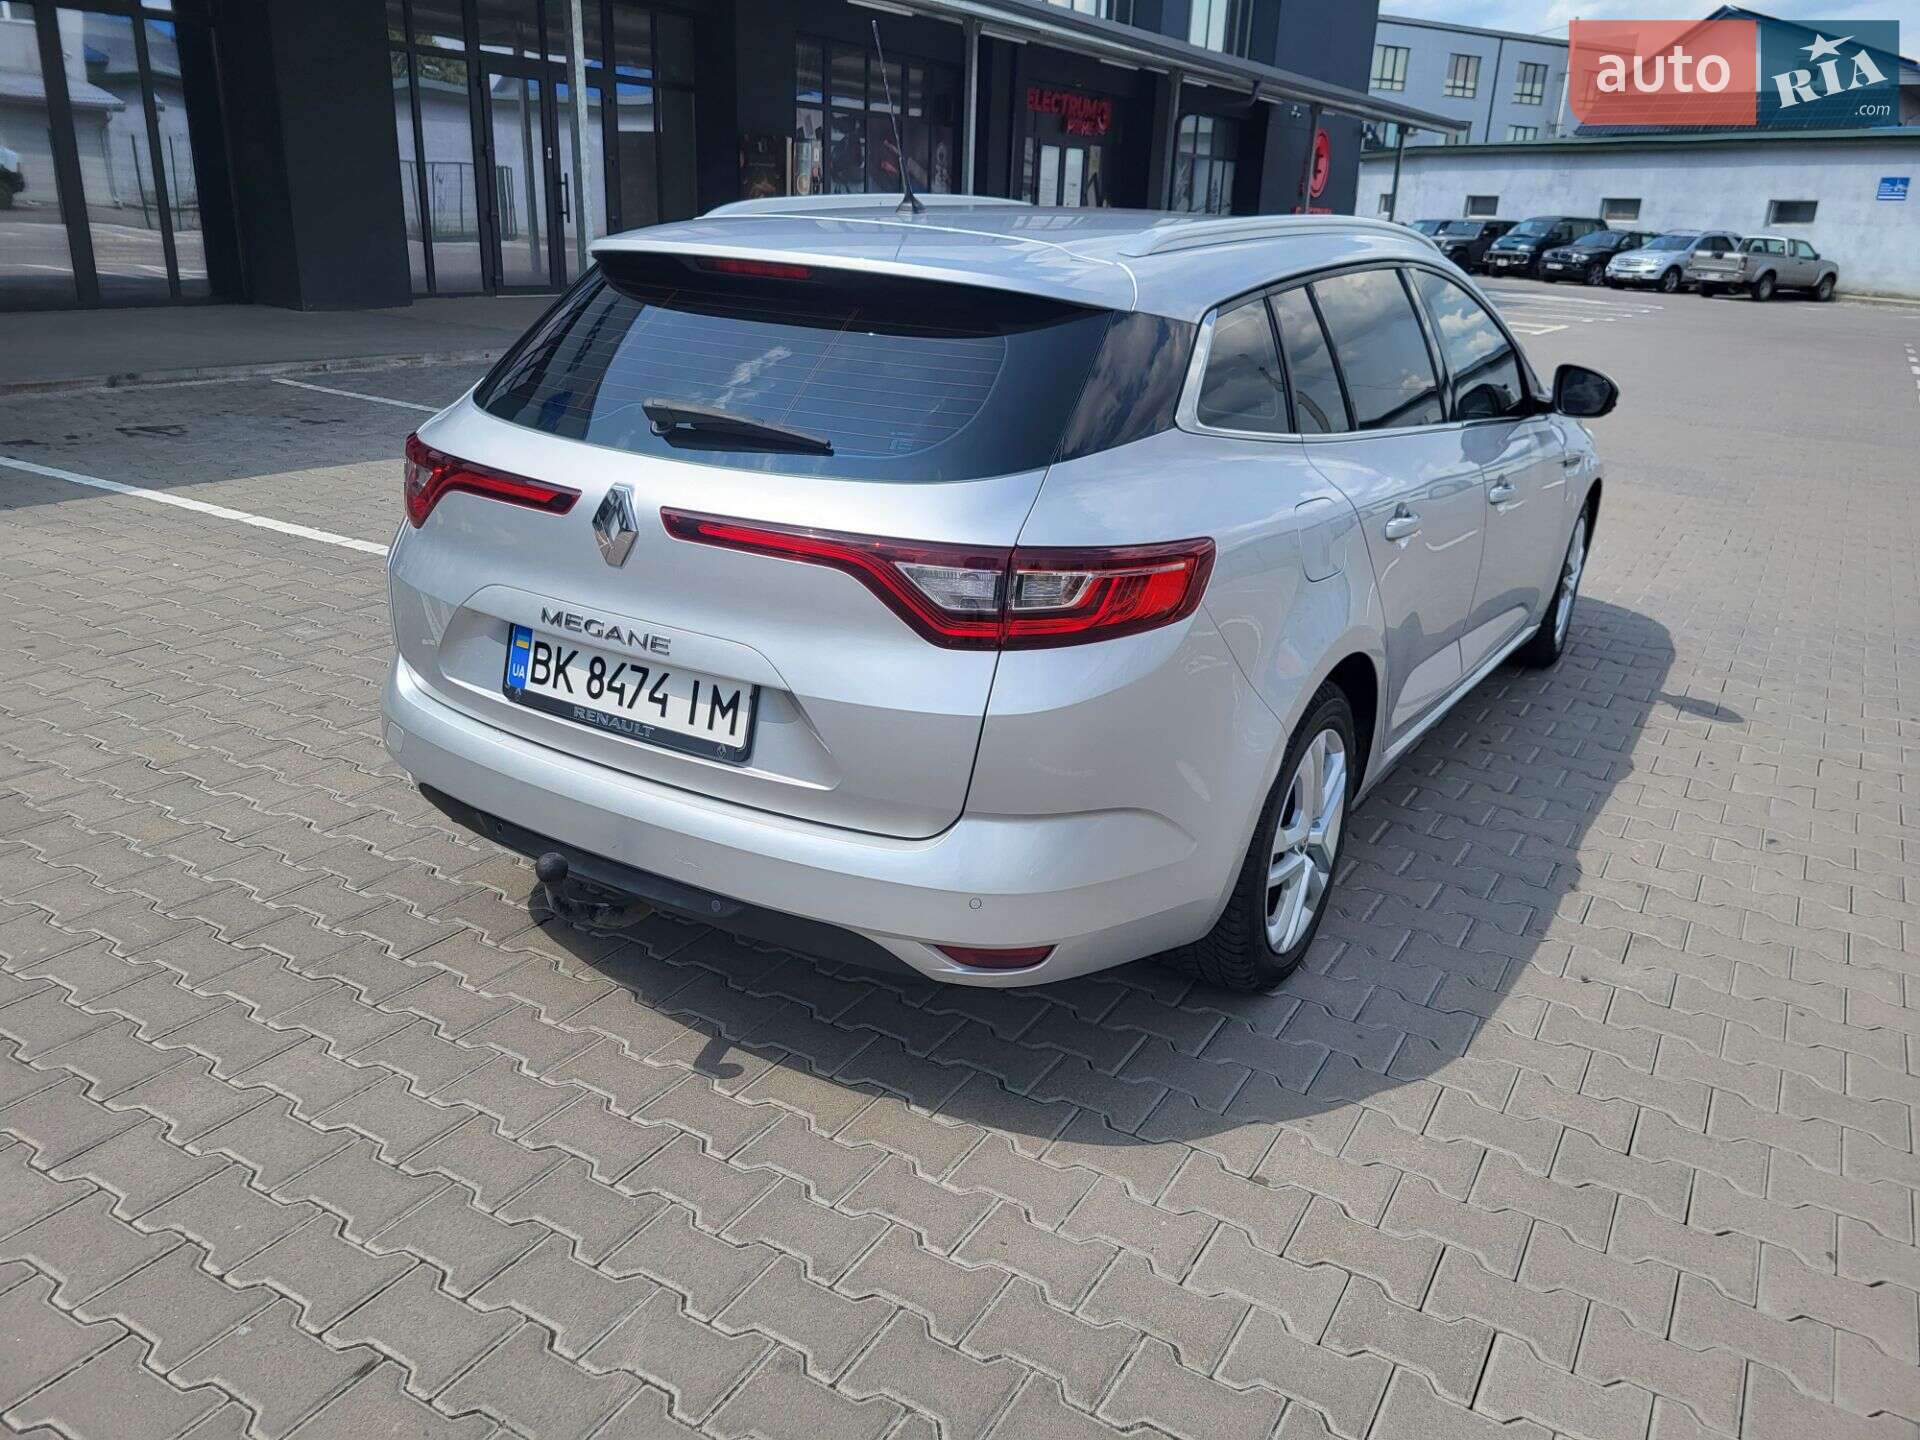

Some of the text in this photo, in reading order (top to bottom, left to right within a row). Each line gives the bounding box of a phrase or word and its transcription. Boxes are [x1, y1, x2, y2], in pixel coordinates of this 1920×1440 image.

[541, 607, 671, 656] MEGANE
[512, 663, 525, 679] UA
[530, 640, 741, 736] BK 8474 IM
[573, 706, 654, 738] RENAULT
